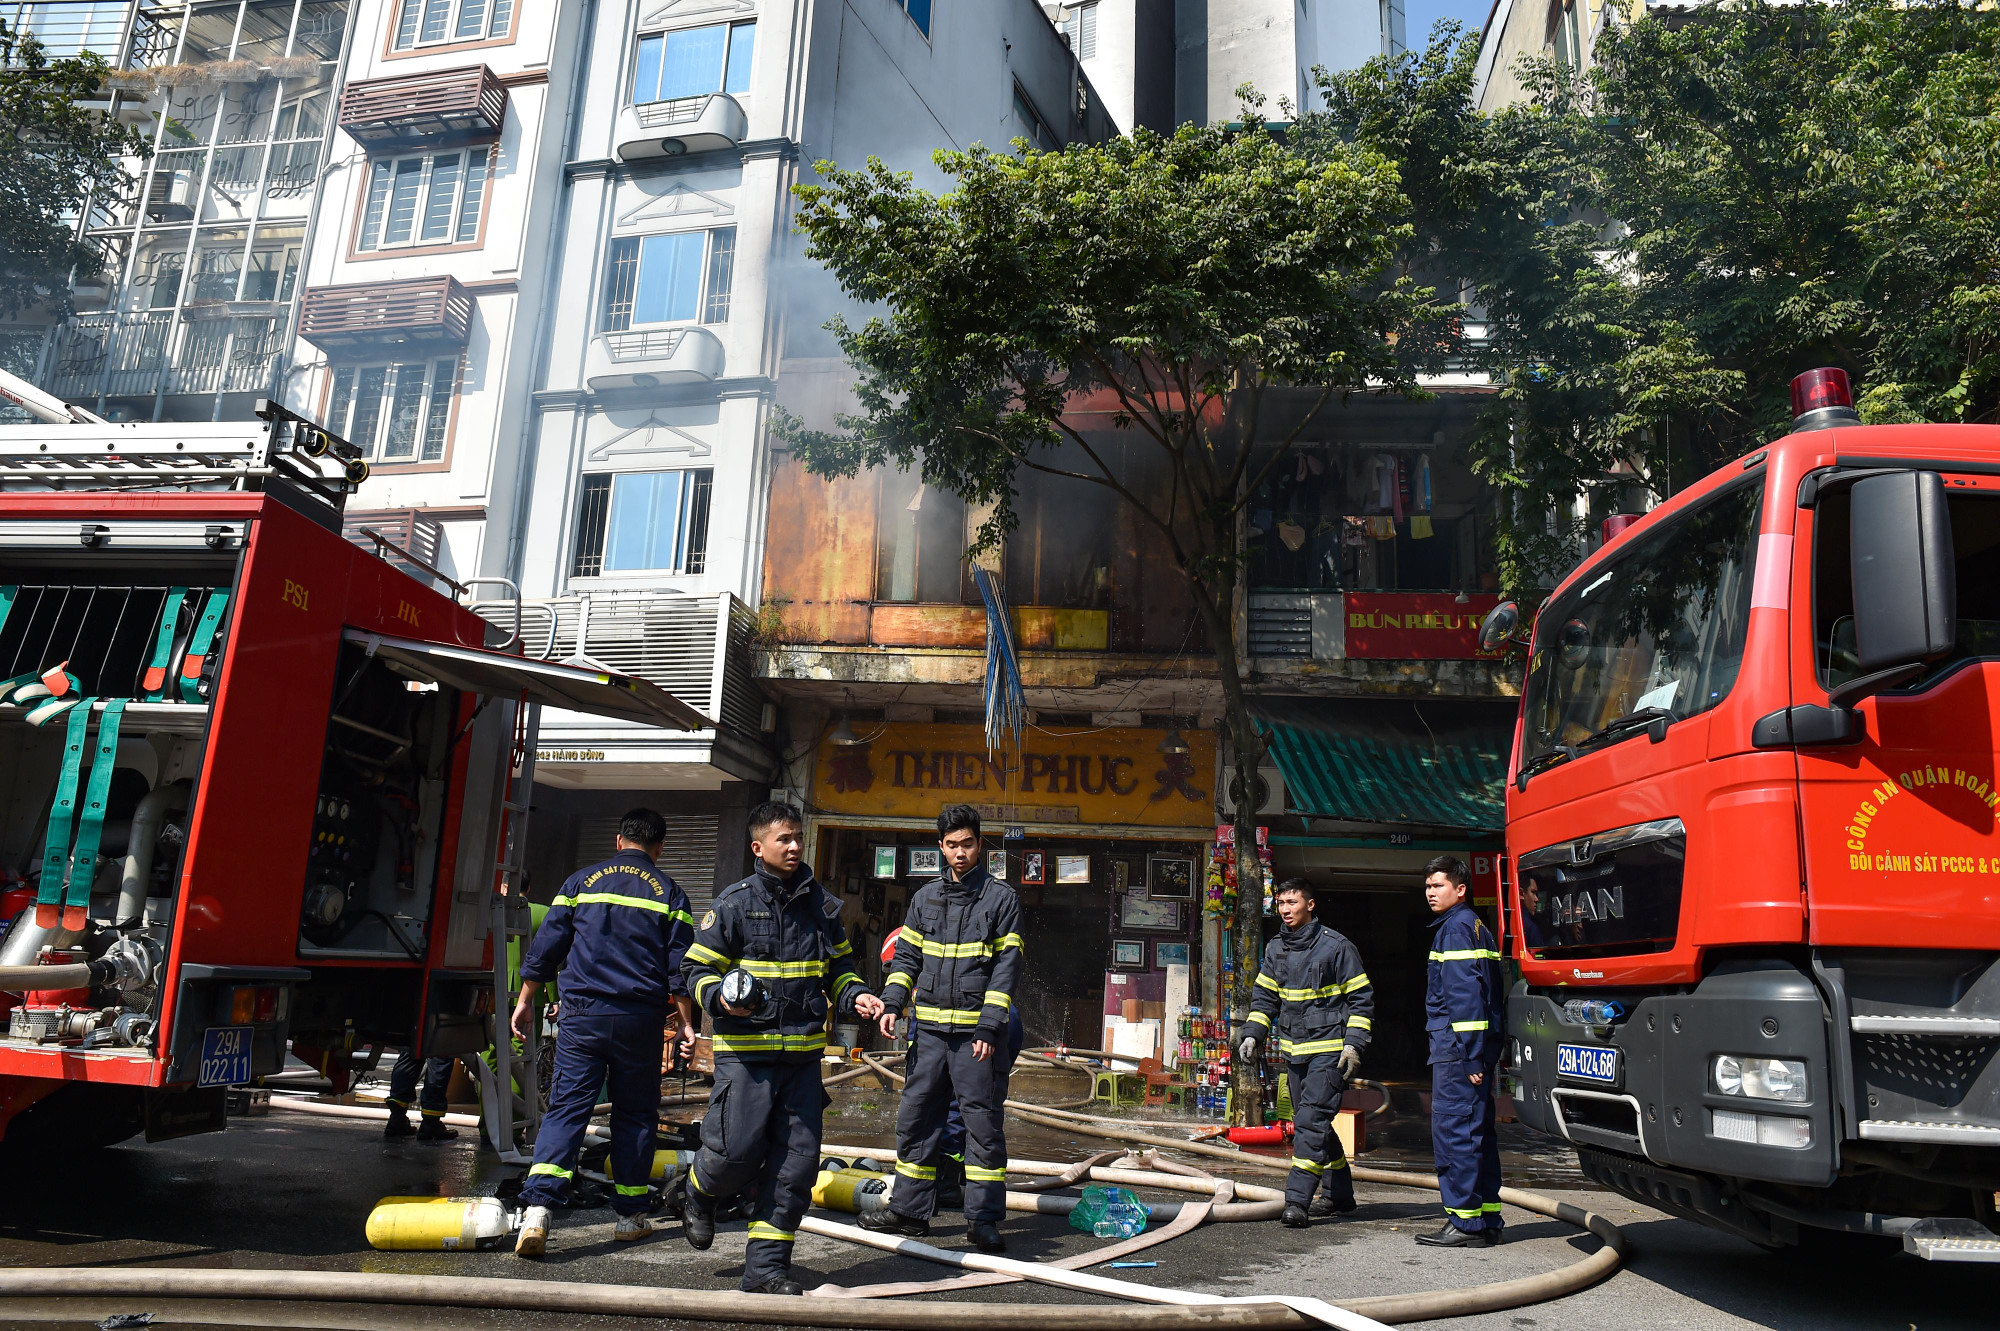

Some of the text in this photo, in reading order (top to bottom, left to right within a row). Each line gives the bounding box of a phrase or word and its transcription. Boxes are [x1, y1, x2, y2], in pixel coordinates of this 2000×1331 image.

[282, 578, 309, 611] PS1
[397, 600, 422, 627] HK
[1350, 608, 1401, 629] BÚN
[1405, 609, 1461, 630] RIÊU
[1872, 779, 1899, 805] AN
[1900, 764, 1950, 790] QUẬN
[620, 865, 640, 875] PCCC
[1474, 857, 1497, 875] B
[1875, 850, 1911, 872] CẢNH
[1914, 852, 1937, 872] SÁT
[1941, 857, 1975, 873] PCCC
[1978, 858, 1988, 874] &
[1551, 886, 1624, 926] MAN
[214, 1030, 241, 1056] 29A
[200, 1056, 248, 1084] 022.11
[1559, 1047, 1613, 1077] 29A-024.68
